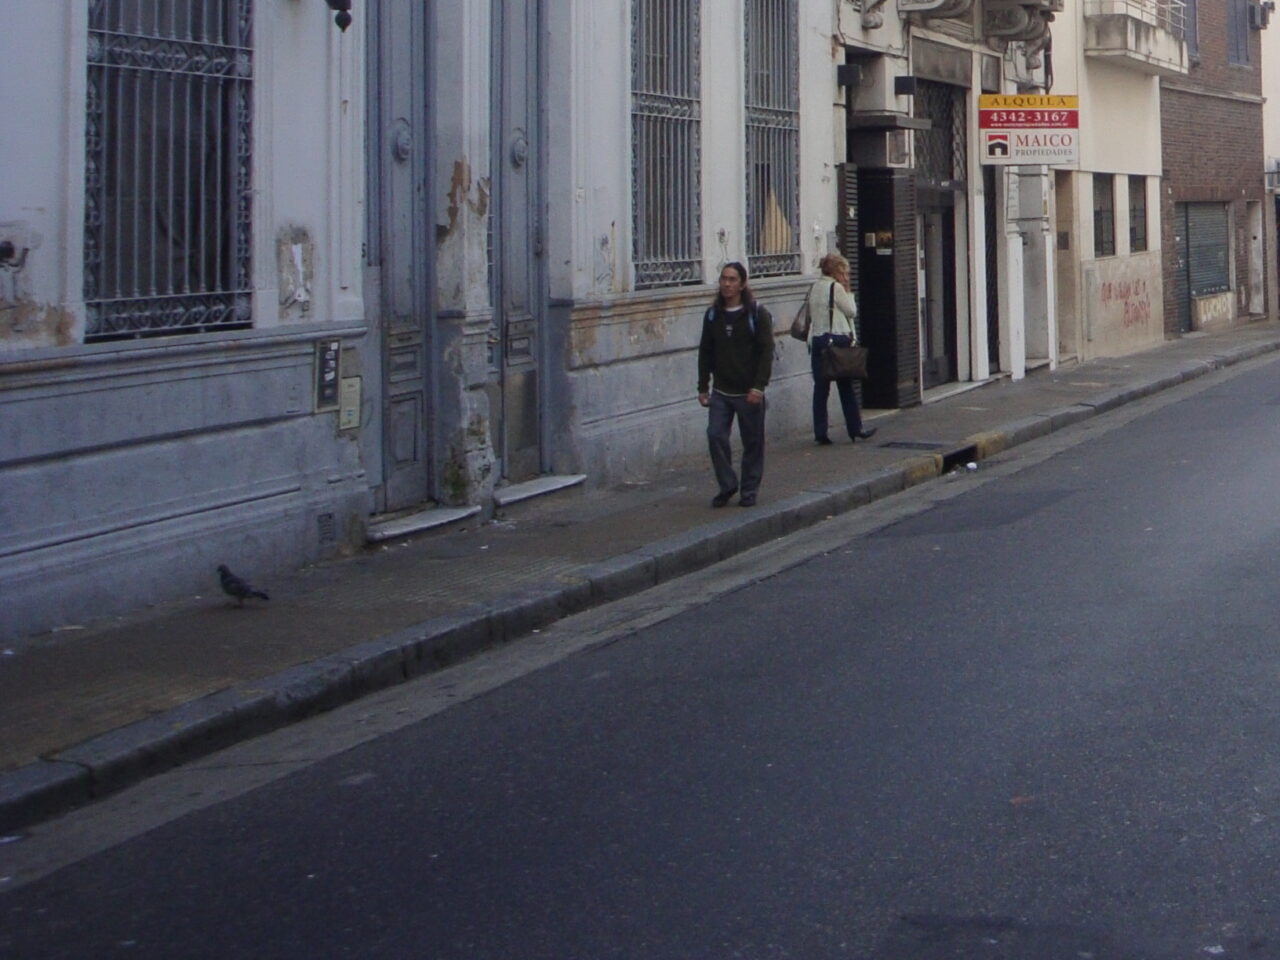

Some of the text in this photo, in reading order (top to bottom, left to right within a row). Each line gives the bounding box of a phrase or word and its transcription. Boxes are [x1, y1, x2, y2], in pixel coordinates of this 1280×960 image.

[991, 97, 1067, 107] ALQUILA
[990, 111, 1069, 122] 4342-3167
[1016, 134, 1073, 147] MAICO
[1016, 148, 1073, 157] PROPIEDADES
